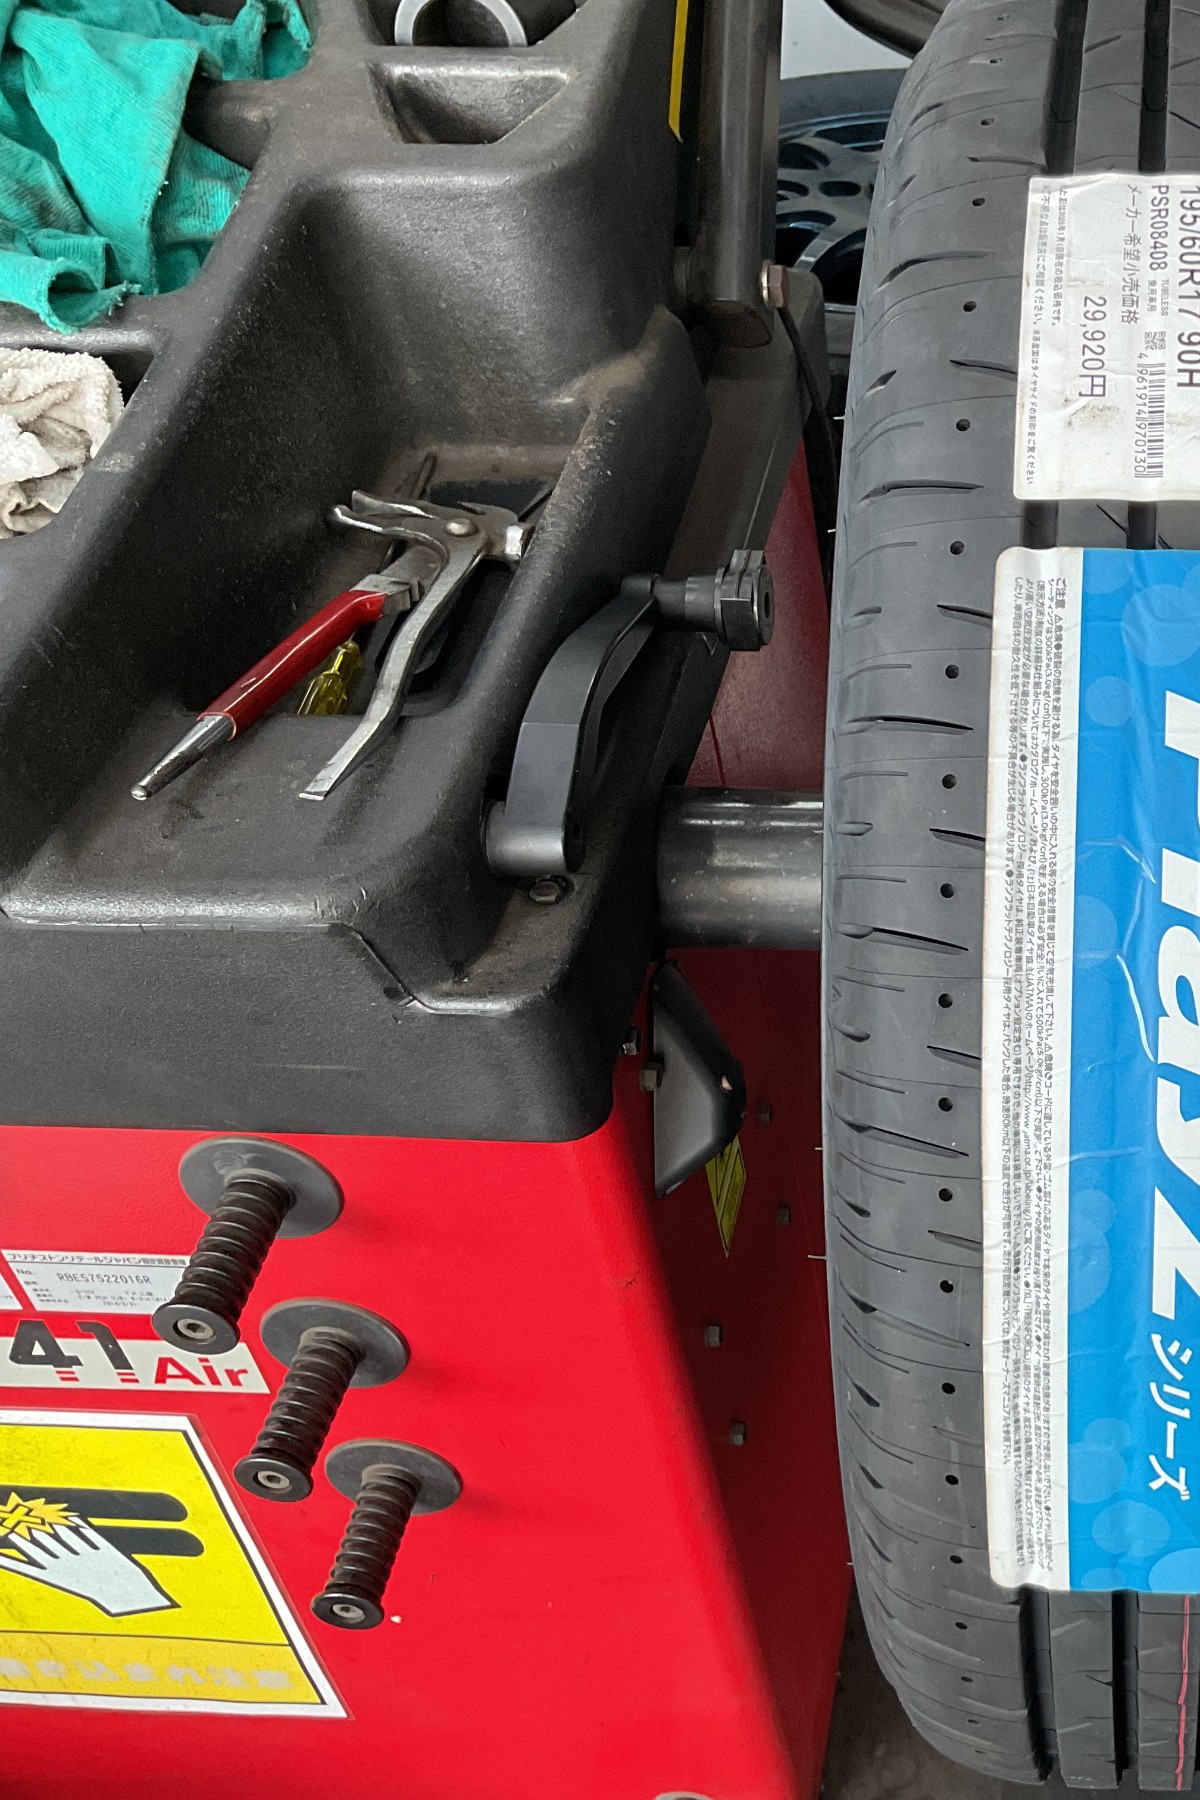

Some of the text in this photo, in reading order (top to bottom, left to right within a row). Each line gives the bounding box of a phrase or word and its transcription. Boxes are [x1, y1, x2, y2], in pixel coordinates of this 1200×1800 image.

[1149, 184, 1170, 271] PSR08408
[1121, 184, 1140, 324] メーカー希望小売価格
[1160, 278, 1169, 316] TUBELESS
[1078, 295, 1108, 398] 29,920円
[1055, 577, 1066, 609] ご注意
[6, 1252, 187, 1265] ブリヂストンリテールジャパン
[56, 1272, 152, 1285] RBE57522016R
[154, 1356, 250, 1387] Air
[1149, 1334, 1192, 1500] シリーズ
